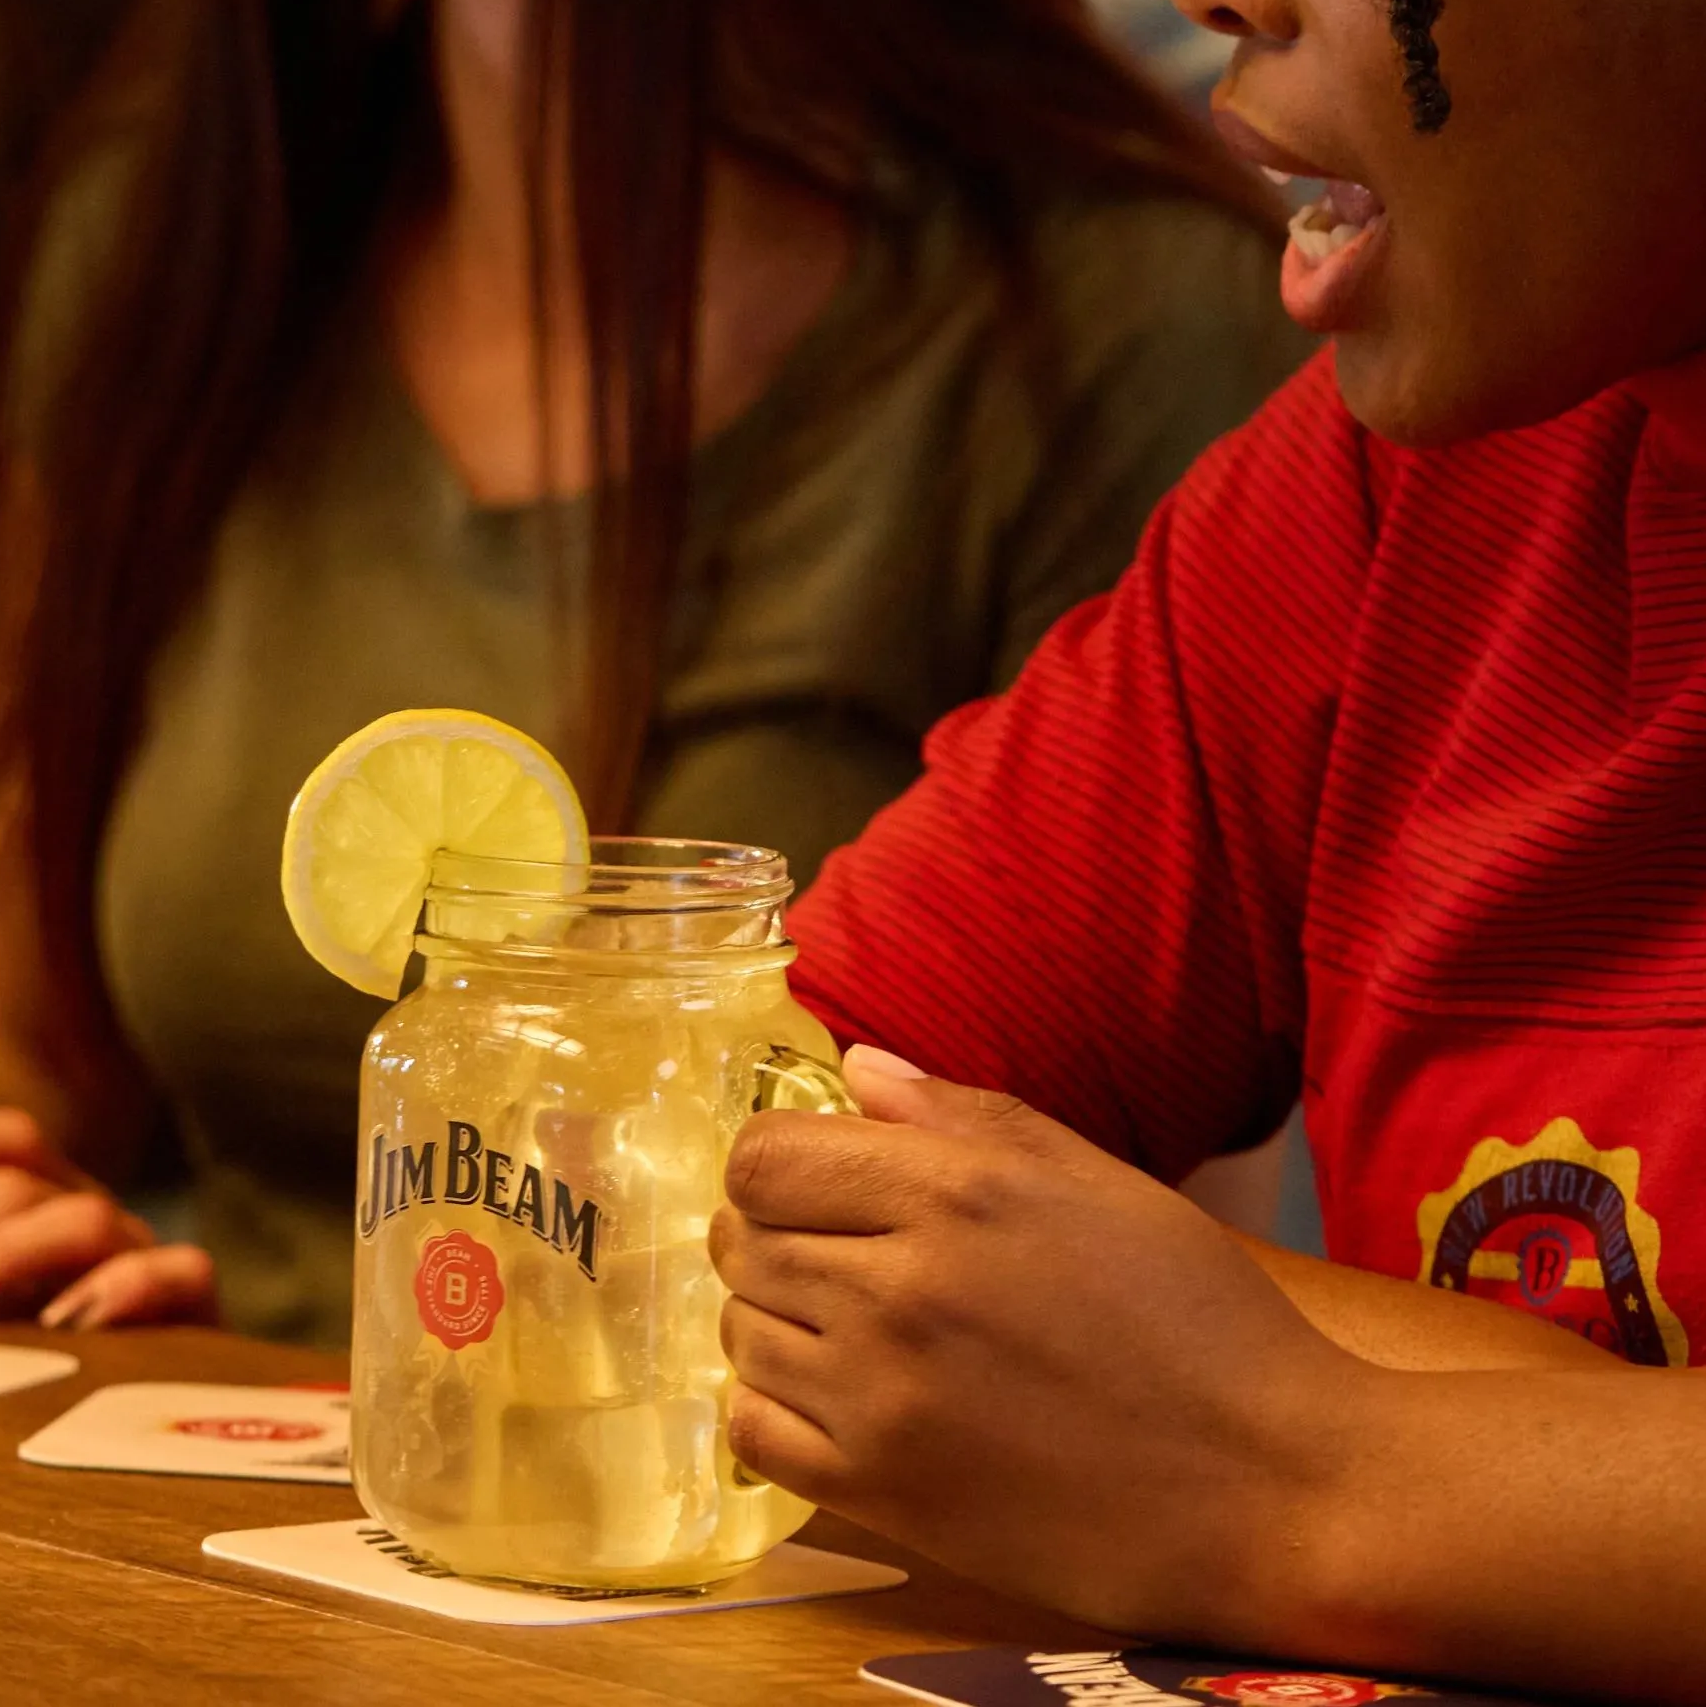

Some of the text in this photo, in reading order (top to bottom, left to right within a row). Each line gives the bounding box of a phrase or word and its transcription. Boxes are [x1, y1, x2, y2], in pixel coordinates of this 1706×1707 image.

[359, 1120, 603, 1282] JIM BEAM
[1501, 1160, 1637, 1285] REVOLUTION
[444, 1272, 468, 1306] B
